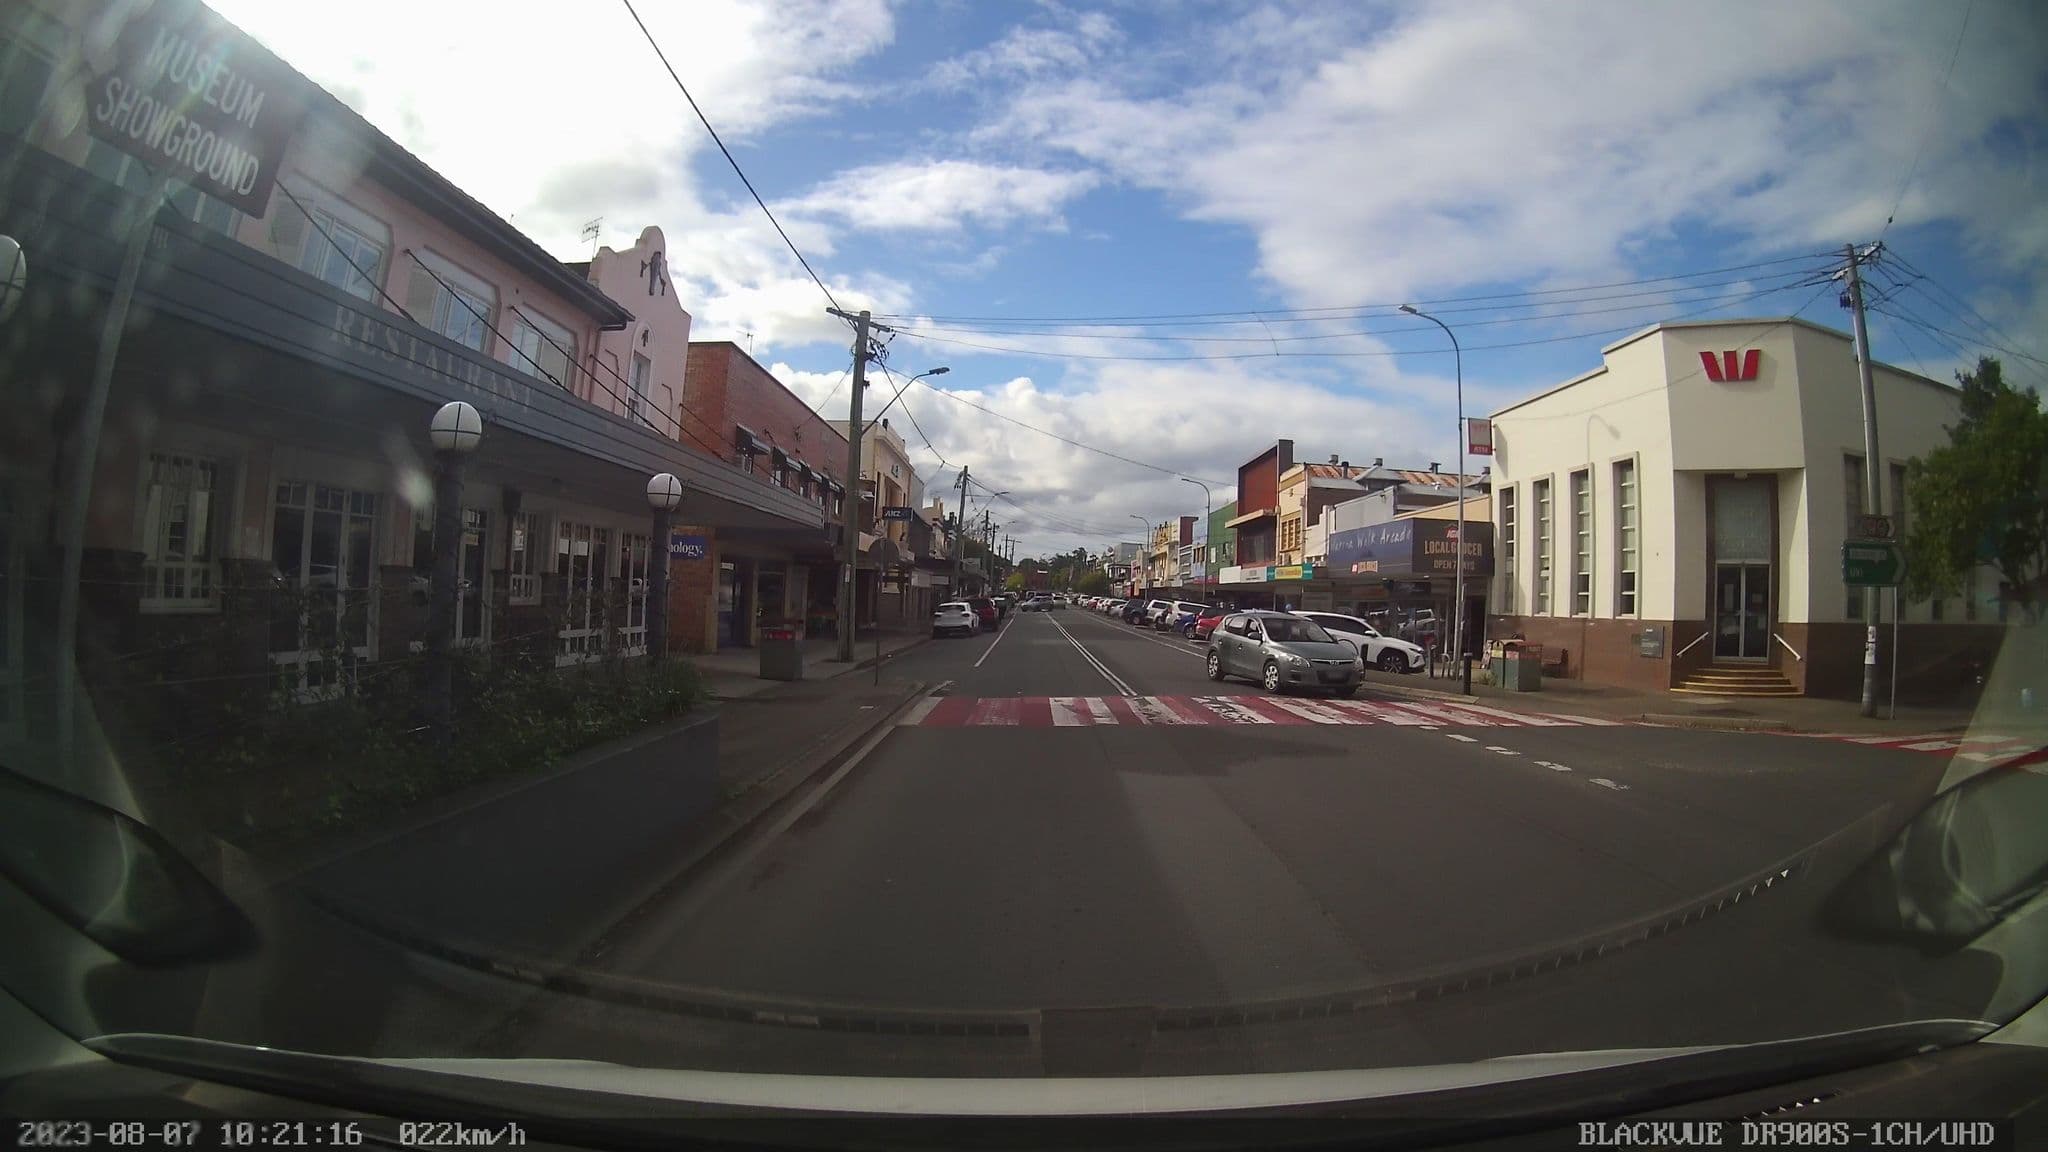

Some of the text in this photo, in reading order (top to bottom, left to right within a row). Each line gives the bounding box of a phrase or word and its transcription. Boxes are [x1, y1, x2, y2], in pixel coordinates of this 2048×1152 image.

[148, 26, 265, 128] MUSEUM
[96, 76, 260, 196] SHOWGROUND
[331, 303, 535, 413] RESTAURANT
[1424, 540, 1482, 557] LOCAL GOCER
[1433, 559, 1451, 569] OPEN
